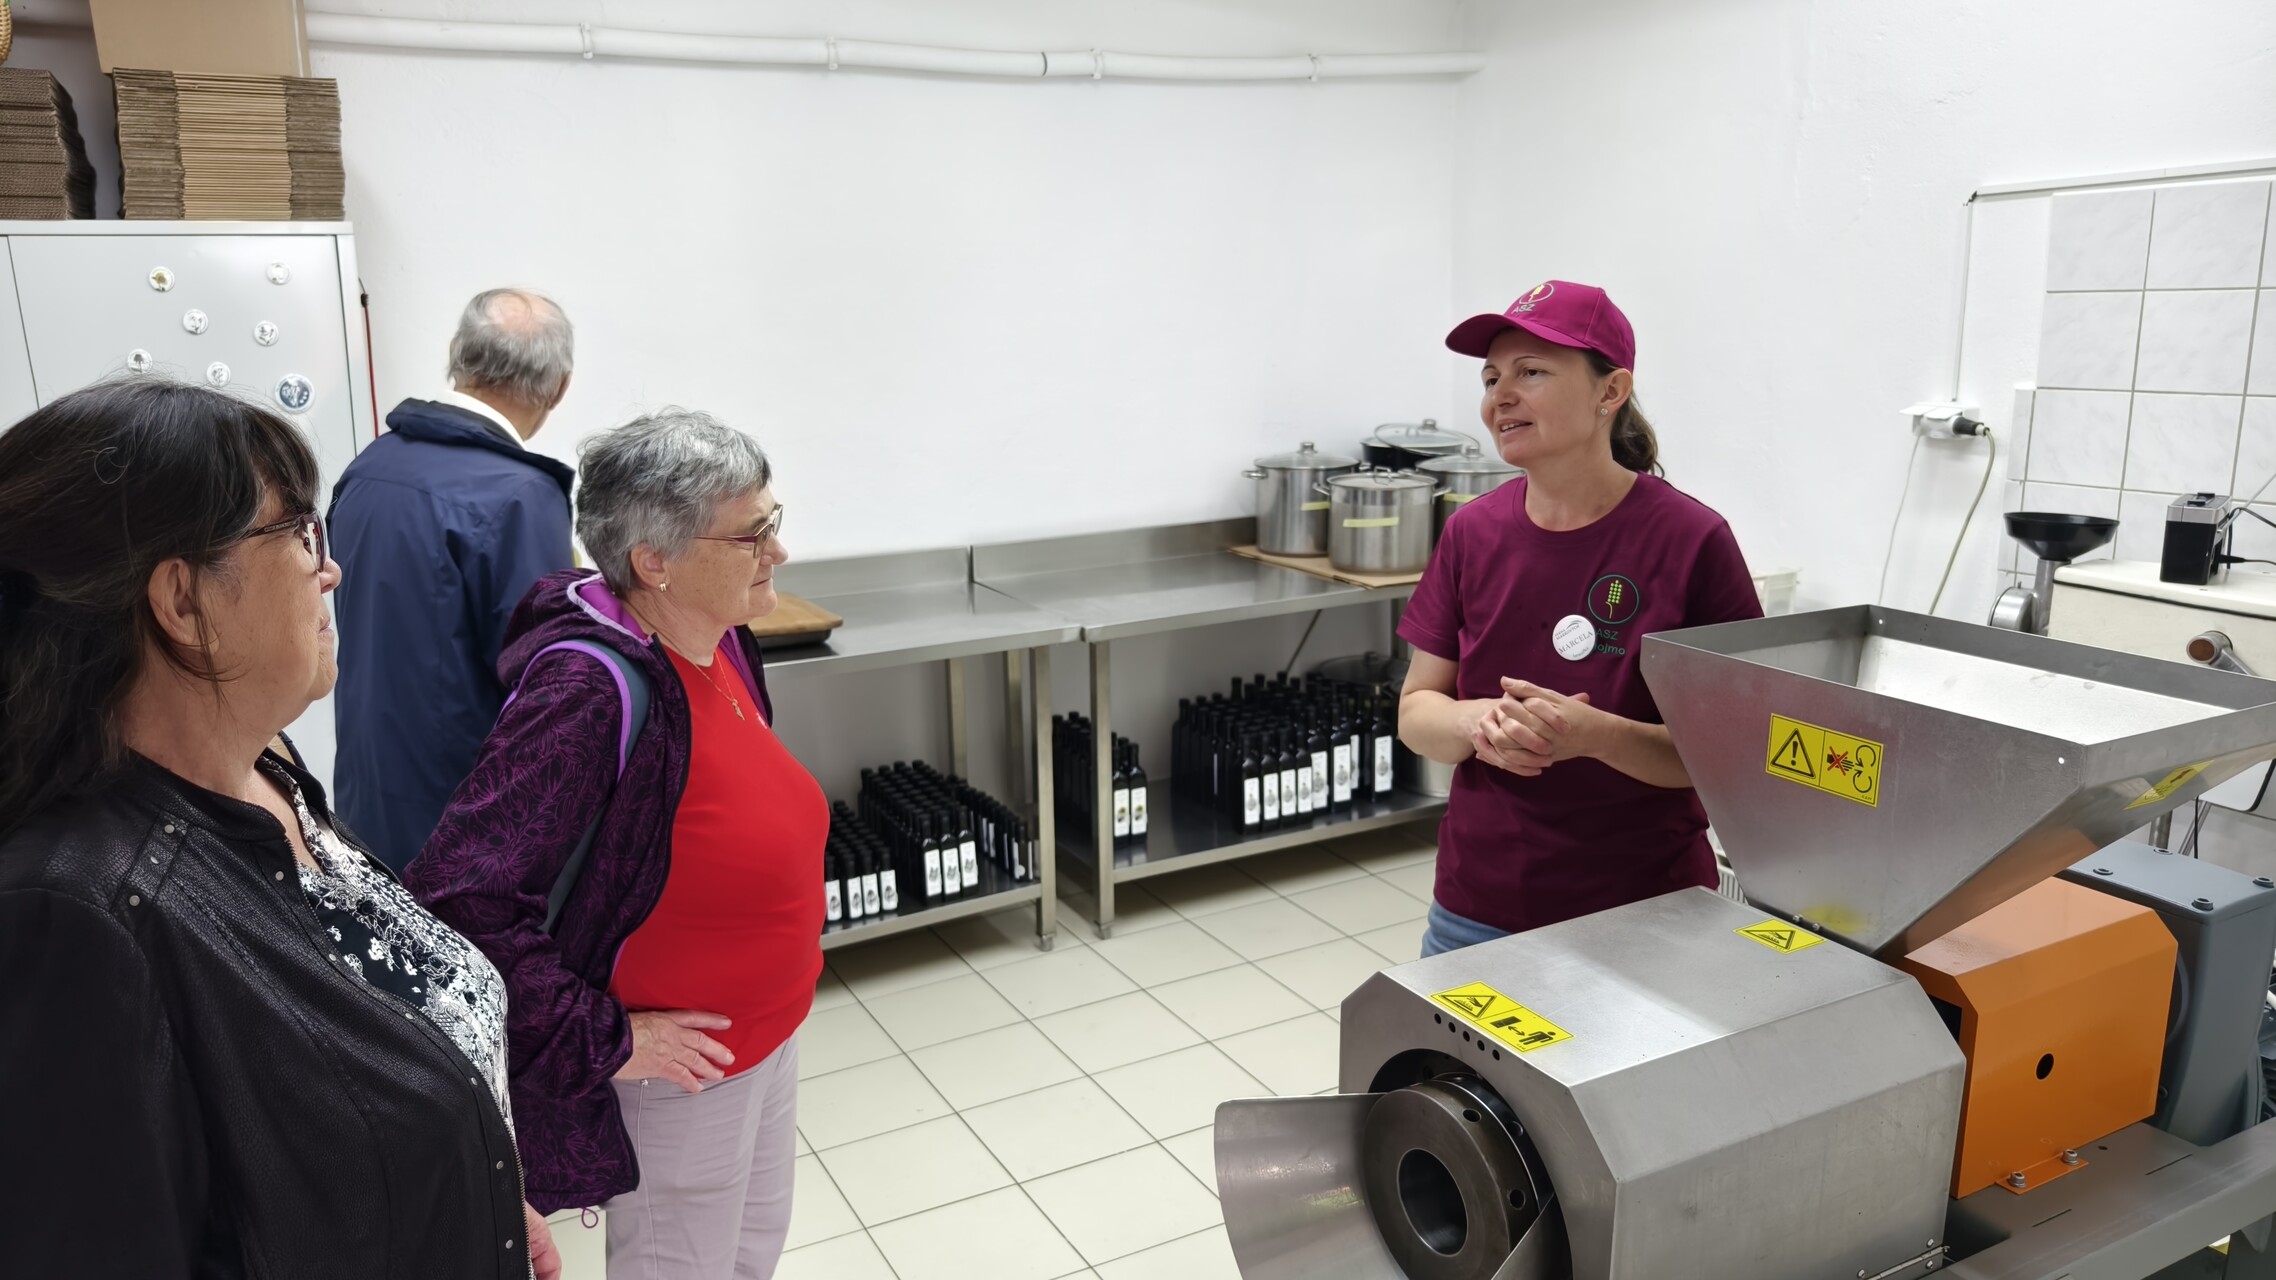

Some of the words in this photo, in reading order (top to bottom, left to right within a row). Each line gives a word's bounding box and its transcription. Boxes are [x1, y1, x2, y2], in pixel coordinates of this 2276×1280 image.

[1511, 304, 1535, 314] ASZ
[1595, 628, 1619, 640] ASZ
[1558, 631, 1593, 654] MARCELA
